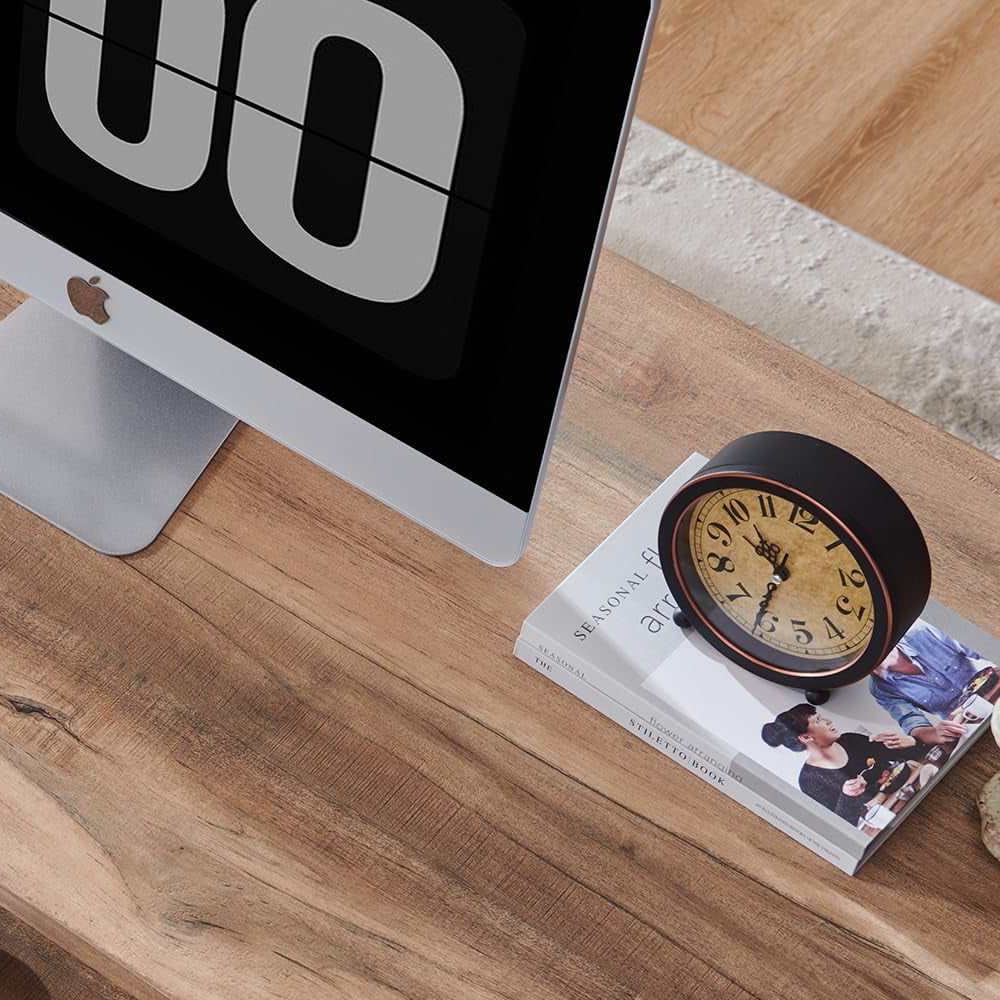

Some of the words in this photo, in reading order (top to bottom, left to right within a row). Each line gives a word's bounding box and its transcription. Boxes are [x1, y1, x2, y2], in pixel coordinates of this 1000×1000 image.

[722, 498, 750, 526] 10
[757, 494, 777, 518] 11
[788, 503, 819, 535] 12
[707, 522, 732, 547] 9
[707, 552, 735, 573] 8
[838, 568, 866, 589] 2
[726, 582, 752, 602] 7
[574, 572, 649, 642] SEASONAL
[836, 595, 866, 621] 3
[790, 619, 813, 645] 5
[823, 616, 846, 640] 4
[539, 644, 585, 679] SEASONAL
[534, 656, 553, 672] THE
[629, 718, 687, 761] STILETTO
[692, 760, 726, 786] BOOK
